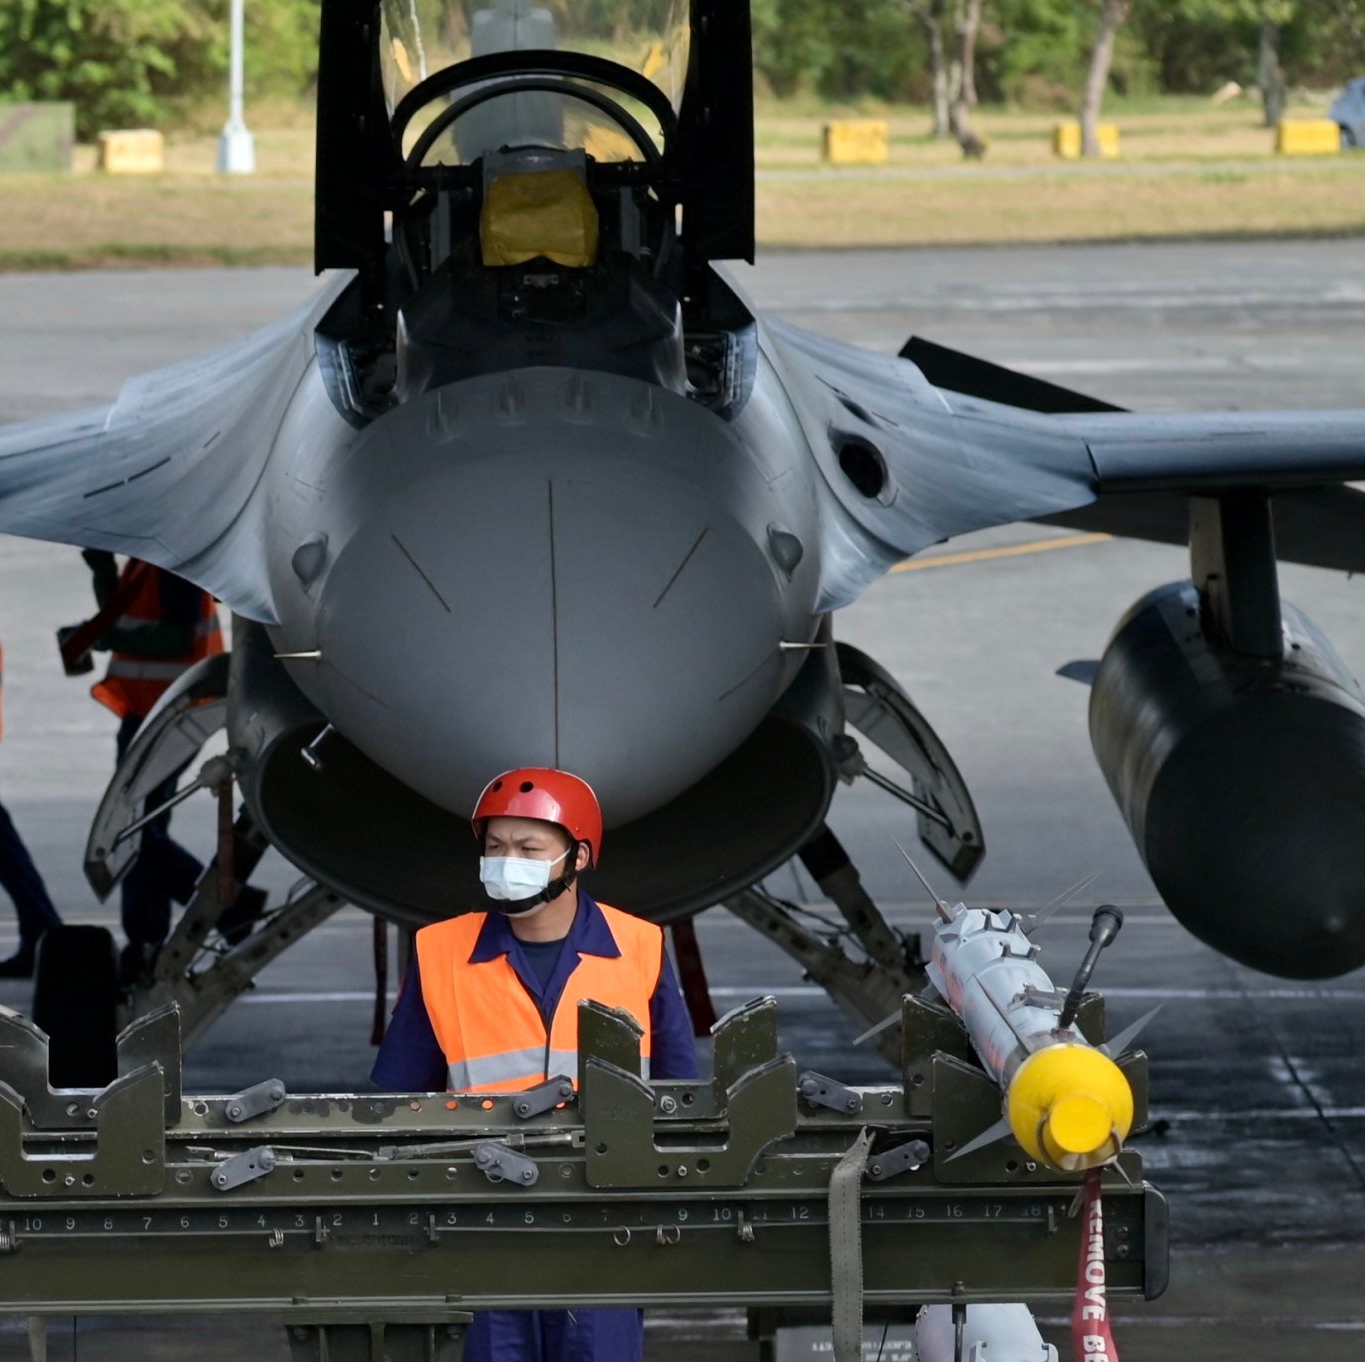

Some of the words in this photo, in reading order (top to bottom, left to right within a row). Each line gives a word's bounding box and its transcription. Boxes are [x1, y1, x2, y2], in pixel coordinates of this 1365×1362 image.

[24, 1217, 43, 1231] 10
[65, 1217, 76, 1231] 9
[103, 1217, 114, 1231] 8
[142, 1217, 152, 1230] 7
[180, 1216, 190, 1229] 6
[218, 1215, 228, 1228] 5
[257, 1214, 267, 1227] 4
[294, 1214, 304, 1228] 3
[332, 1213, 343, 1227] 2
[372, 1212, 380, 1226] 1
[409, 1211, 419, 1225] 2
[447, 1211, 457, 1225] 3
[485, 1211, 495, 1225] 4
[524, 1211, 534, 1224] 5
[677, 1208, 688, 1221] 9
[713, 1208, 732, 1221] 10
[791, 1206, 809, 1219] 12
[869, 1206, 885, 1218] 14
[907, 1205, 925, 1218] 15
[946, 1205, 963, 1218] 16
[984, 1204, 1002, 1217] 17
[1082, 1198, 1108, 1322] REMOVE
